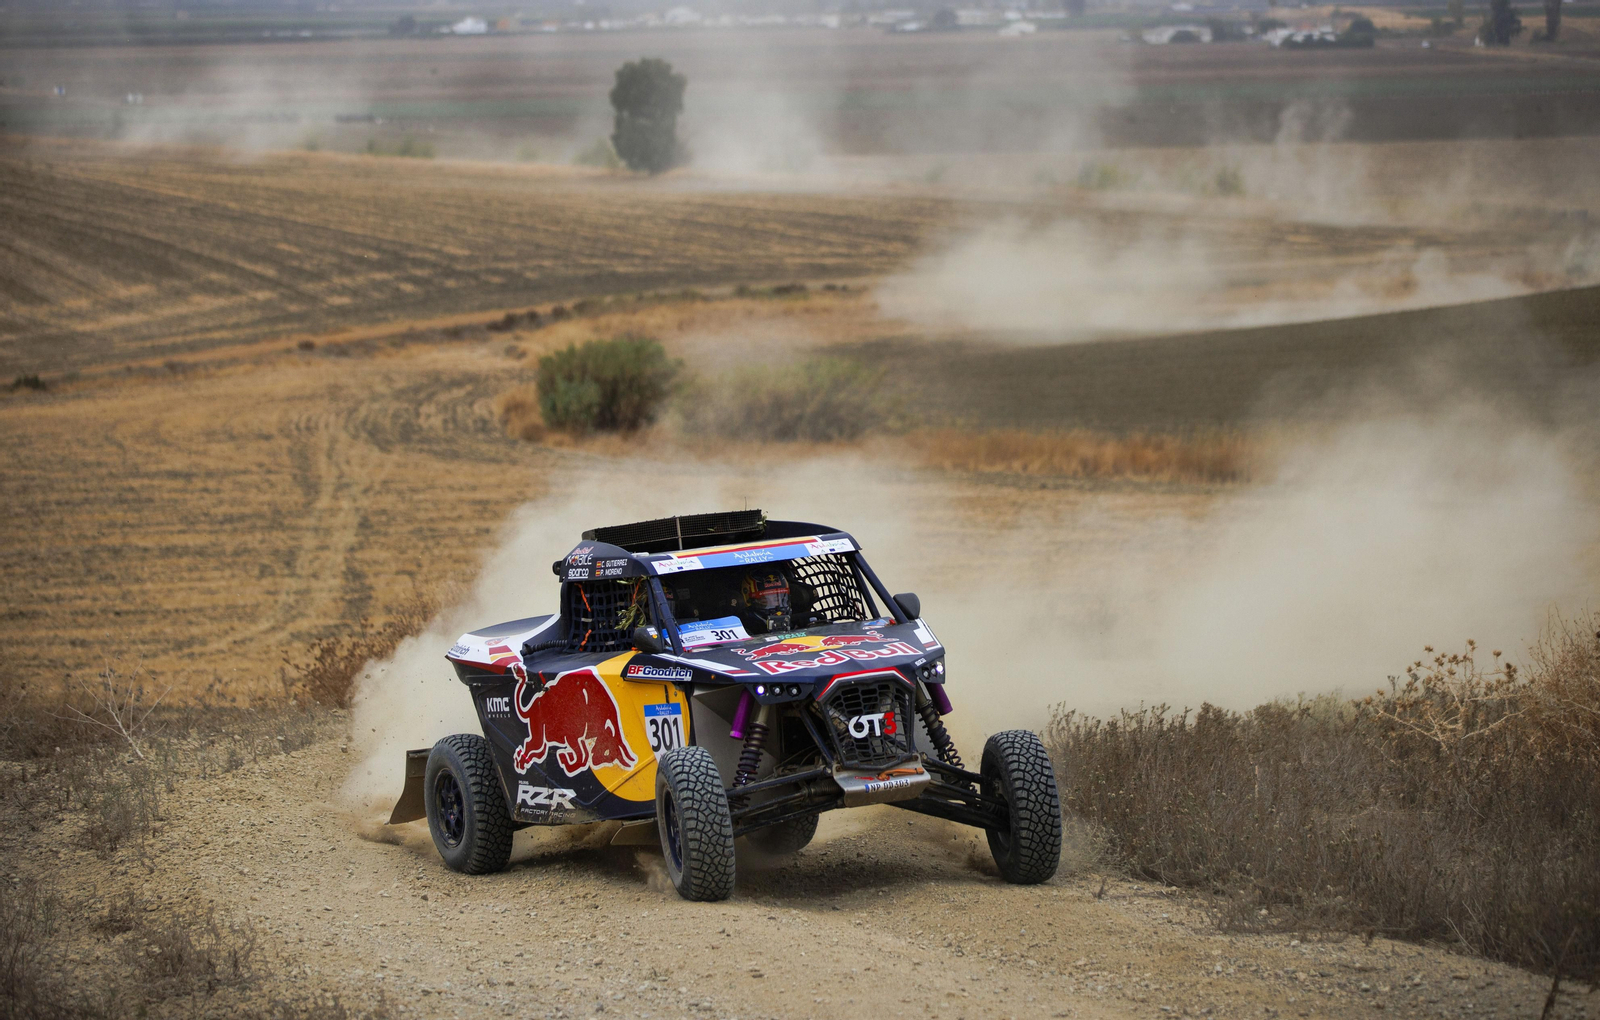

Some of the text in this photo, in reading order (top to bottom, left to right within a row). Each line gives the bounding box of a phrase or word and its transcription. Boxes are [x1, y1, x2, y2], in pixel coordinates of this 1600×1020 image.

[605, 568, 622, 576] MORENO
[710, 629, 739, 641] 301
[753, 641, 924, 676] Red Bull
[627, 665, 693, 678] BFGoodrich
[486, 697, 510, 712] KMC
[649, 717, 682, 753] 301
[517, 785, 577, 811] RZR
[520, 807, 549, 816] FACTORY
